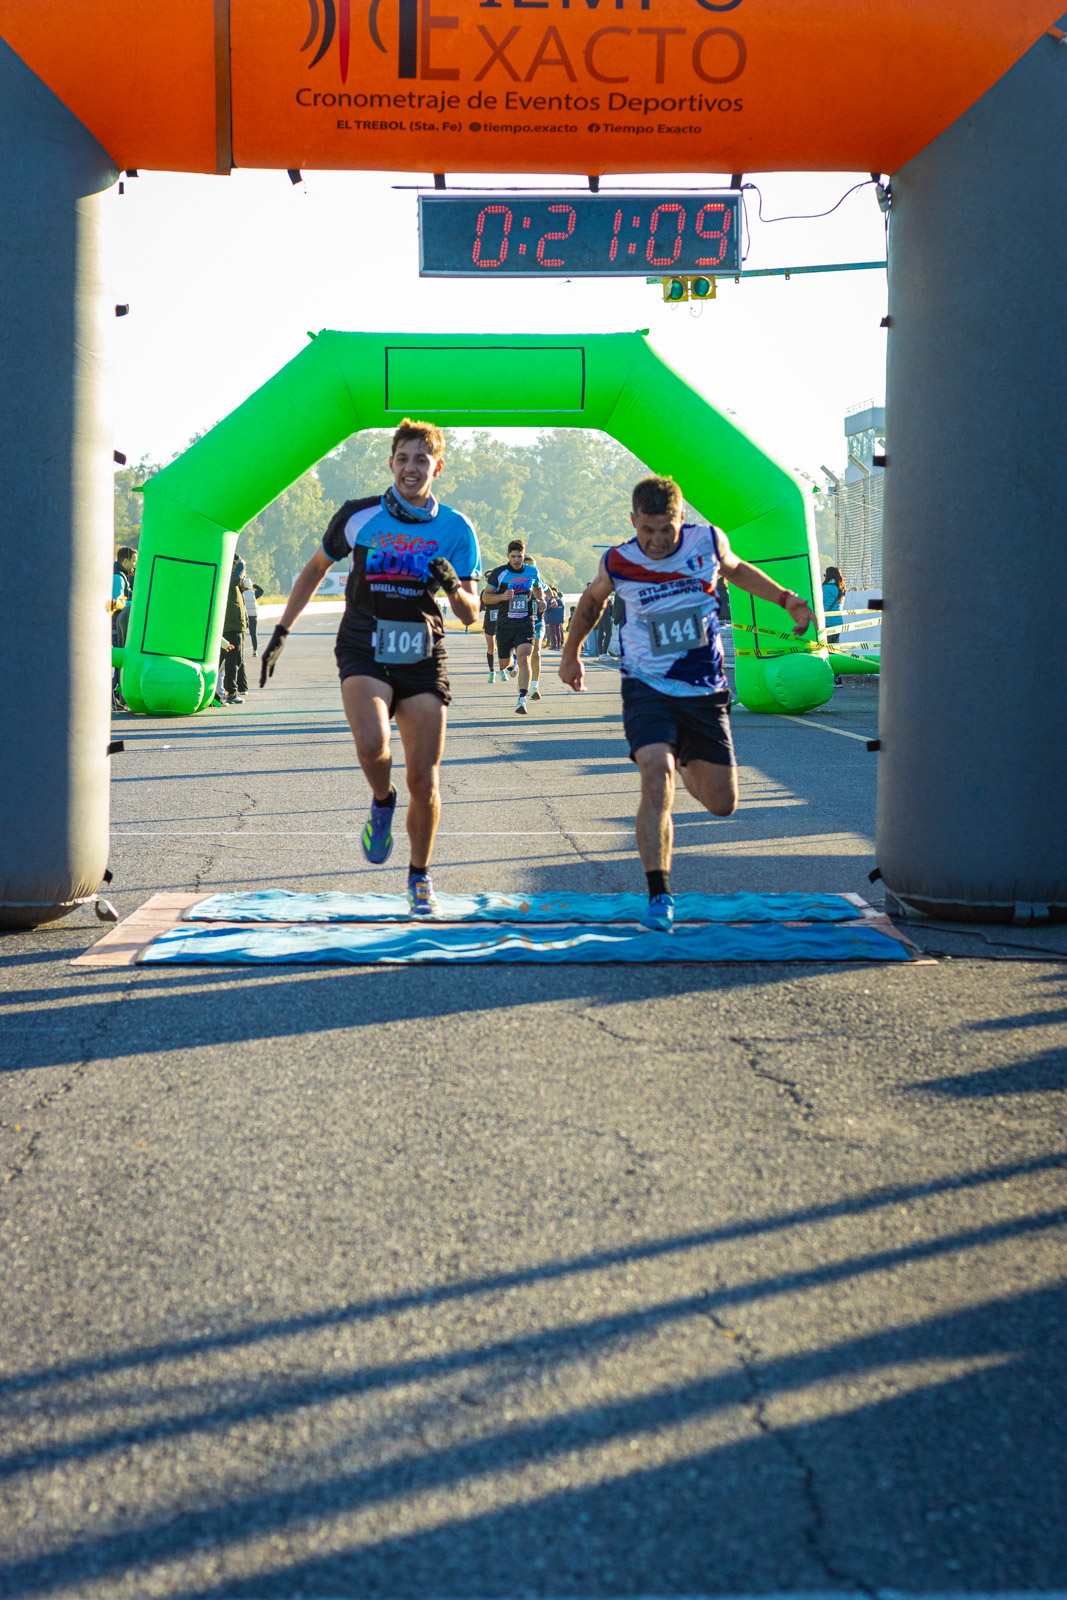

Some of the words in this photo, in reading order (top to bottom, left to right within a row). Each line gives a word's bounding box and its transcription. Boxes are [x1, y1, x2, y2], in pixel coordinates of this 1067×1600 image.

[421, 0, 748, 84] EXACTO
[296, 88, 460, 113] Cronometraje
[467, 90, 498, 110] de
[505, 91, 600, 111] Eventos
[608, 92, 744, 115] Deportivos
[336, 120, 352, 130] EL
[354, 120, 406, 131] TREBOL
[410, 120, 439, 132] (Sta.
[442, 121, 462, 133] Fe)
[483, 122, 578, 134] tiempo.exacto
[603, 123, 654, 135] Tiempo
[657, 123, 702, 134] Exacto
[472, 203, 731, 267] 0:21:09
[512, 600, 526, 609] 129
[387, 630, 423, 654] 104
[658, 617, 697, 646] 144
